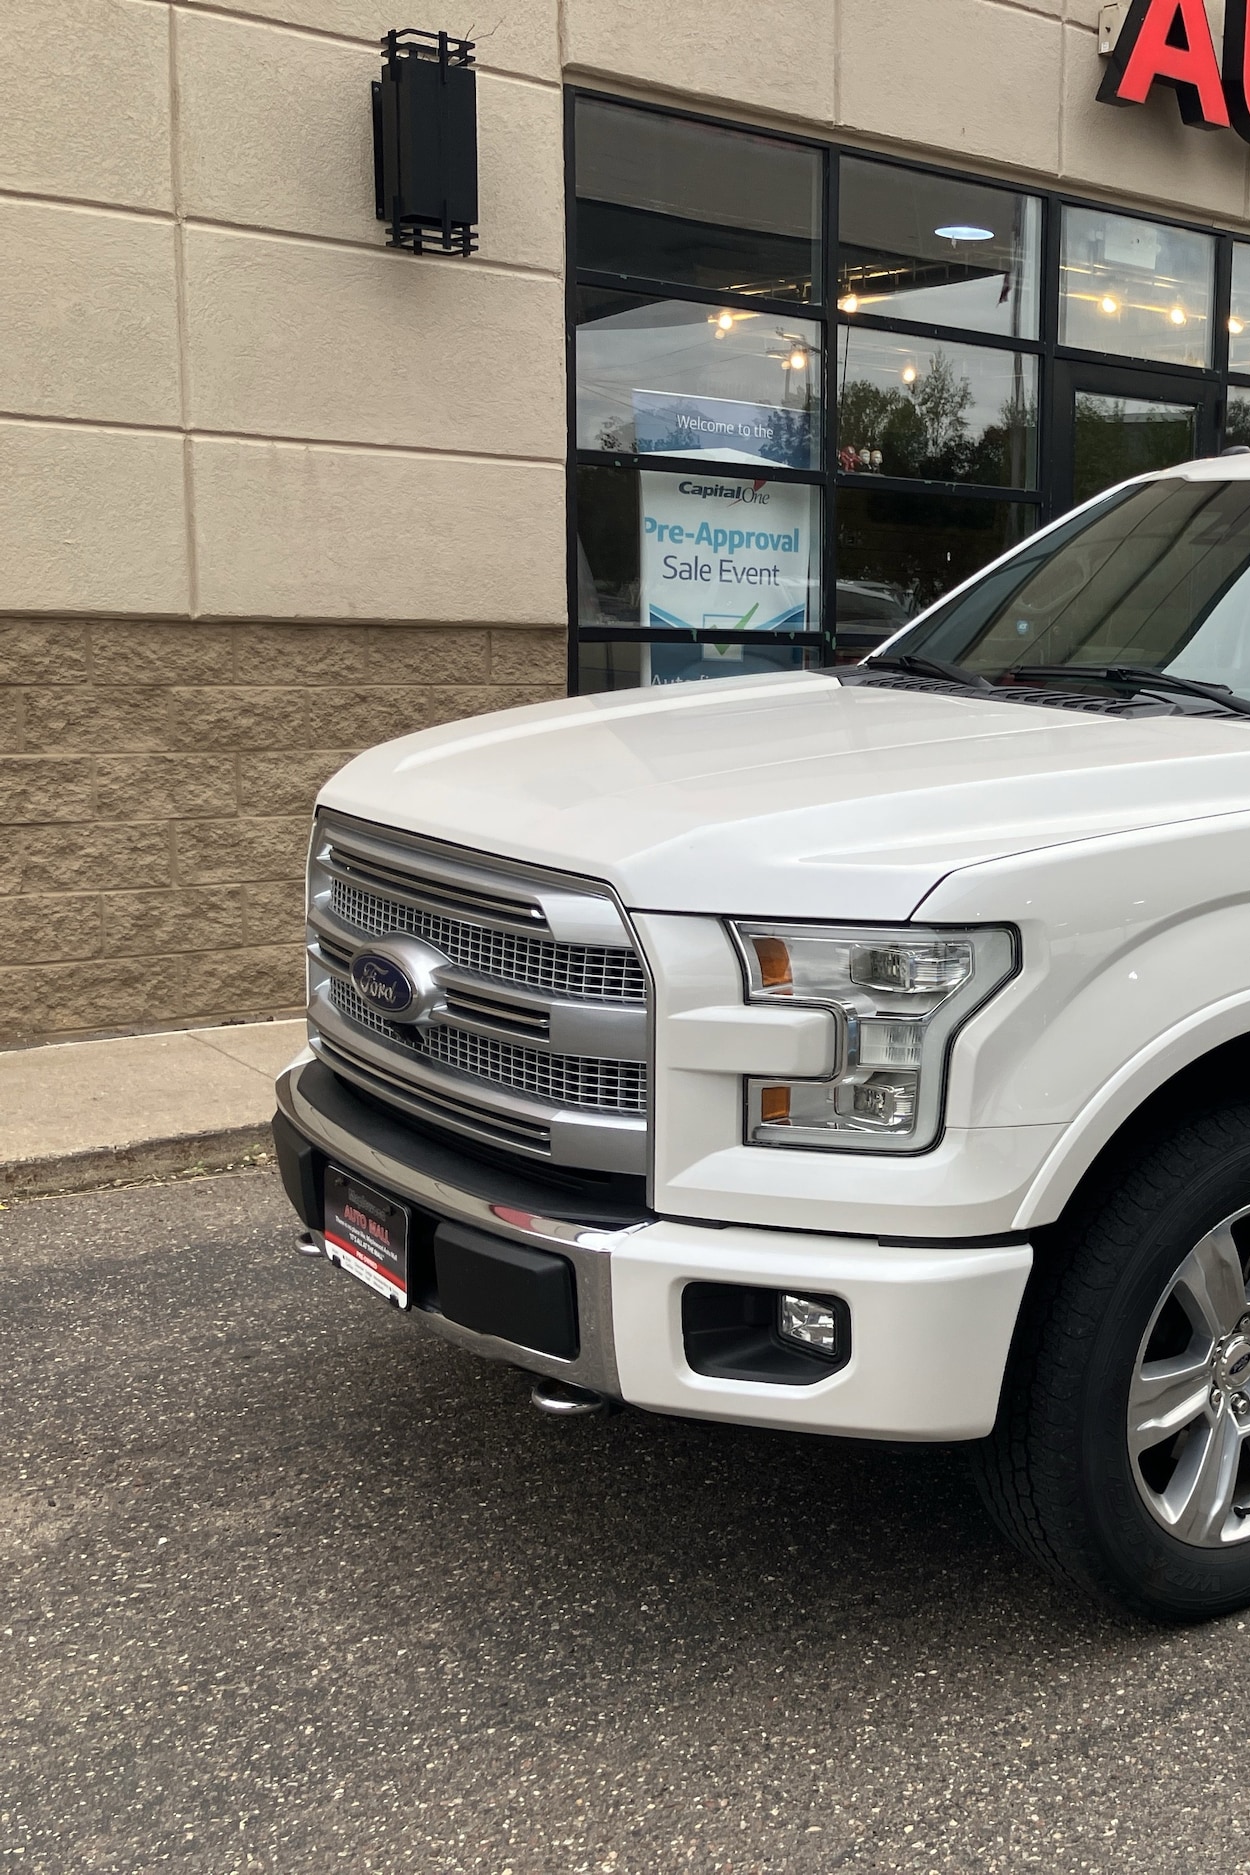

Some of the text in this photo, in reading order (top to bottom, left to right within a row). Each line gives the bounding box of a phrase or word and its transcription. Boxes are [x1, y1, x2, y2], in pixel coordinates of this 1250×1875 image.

[677, 414, 774, 440] Welcome to the
[644, 517, 800, 555] Pre-Approval
[662, 555, 780, 587] Sale Event
[360, 961, 398, 1004] Ford
[343, 1204, 367, 1230] AUTO
